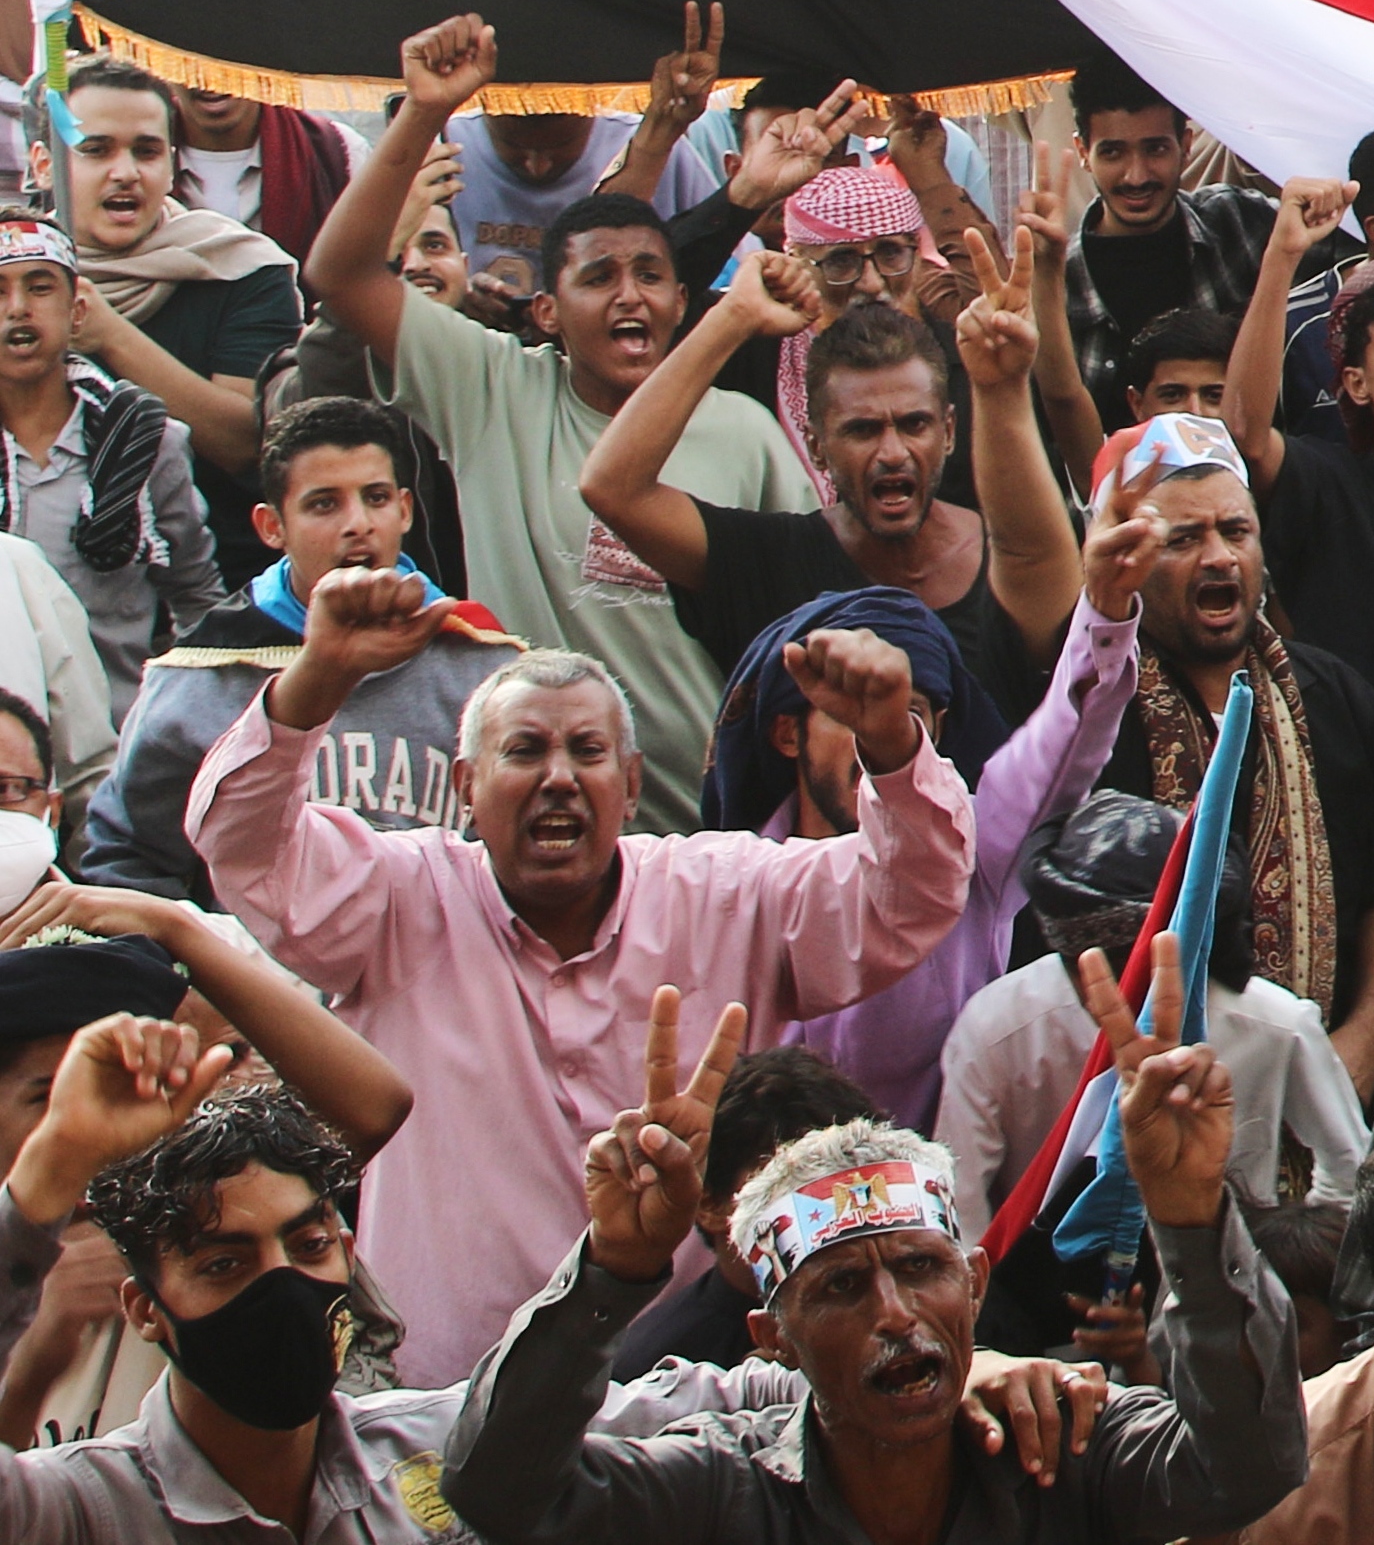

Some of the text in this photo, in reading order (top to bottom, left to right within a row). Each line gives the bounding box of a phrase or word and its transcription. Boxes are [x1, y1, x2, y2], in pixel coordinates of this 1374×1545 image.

[305, 731, 466, 833] ORAD
[810, 1202, 922, 1244] الجنوب العربي
